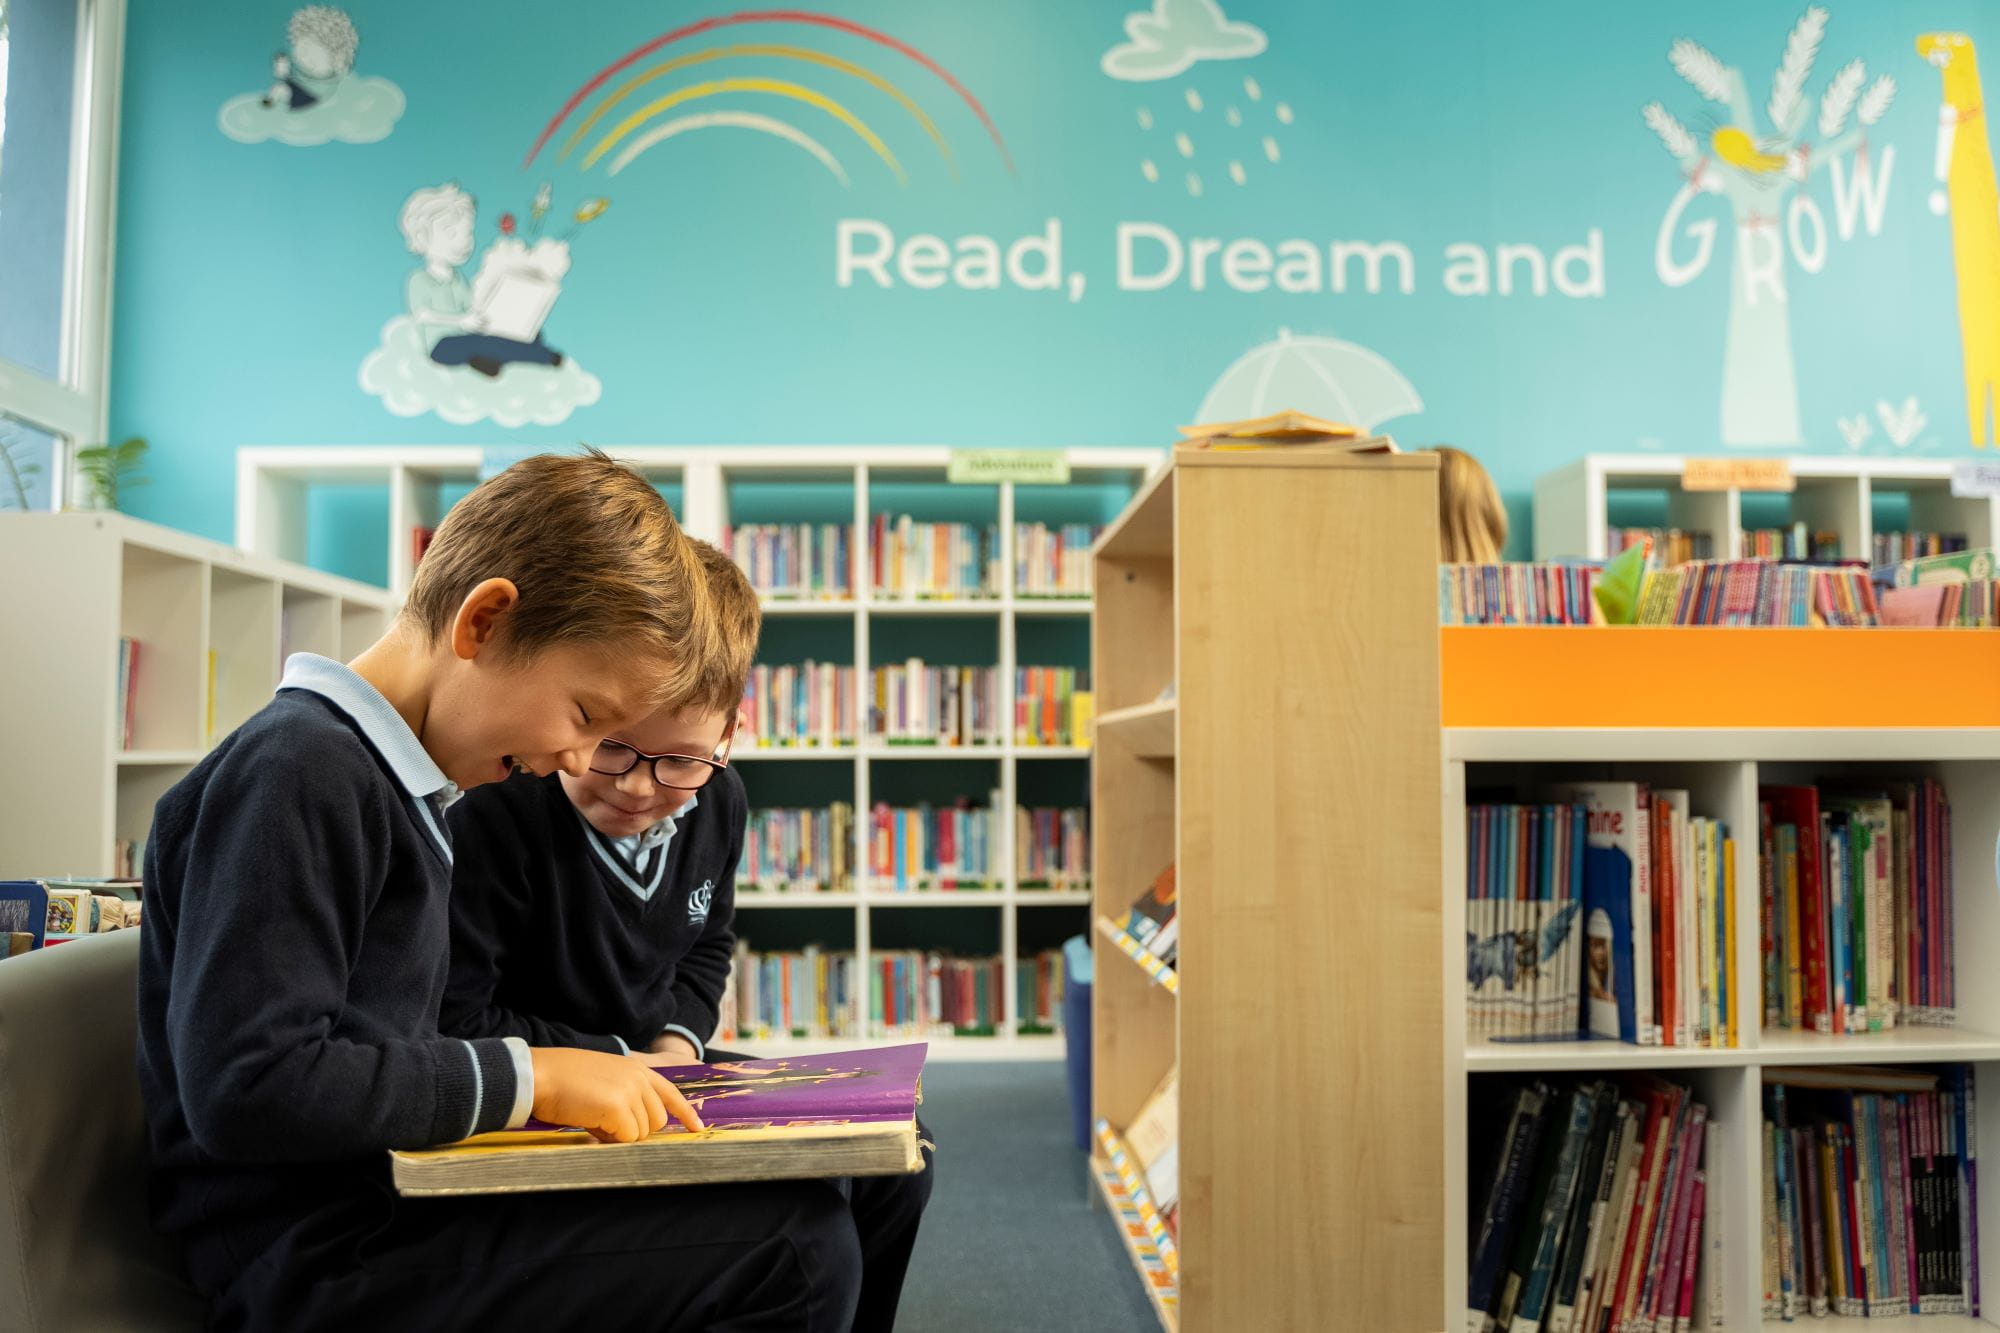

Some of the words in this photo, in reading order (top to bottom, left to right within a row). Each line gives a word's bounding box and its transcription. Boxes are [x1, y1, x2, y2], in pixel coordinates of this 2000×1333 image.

[835, 218, 1086, 304] Read,
[1116, 222, 1415, 295] Dream
[1443, 228, 1605, 298] and
